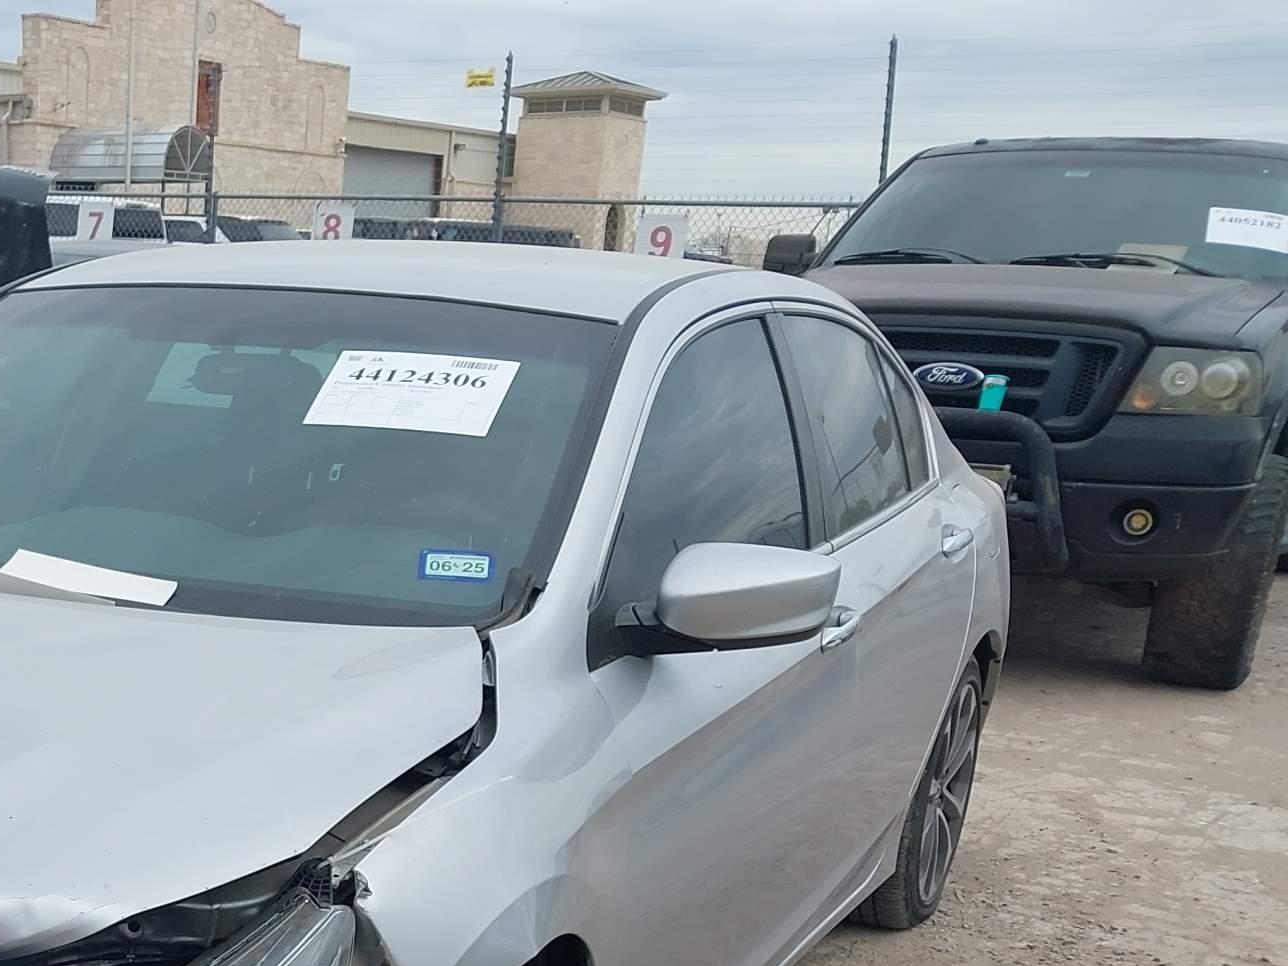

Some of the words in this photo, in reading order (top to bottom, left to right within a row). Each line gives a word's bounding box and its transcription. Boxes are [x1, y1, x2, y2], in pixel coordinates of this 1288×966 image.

[89, 212, 104, 240] 7
[323, 213, 342, 240] 8
[649, 226, 672, 256] 9
[348, 367, 488, 389] 44124306
[928, 366, 967, 384] Ford
[429, 560, 452, 572] 06
[462, 562, 485, 573] 25
